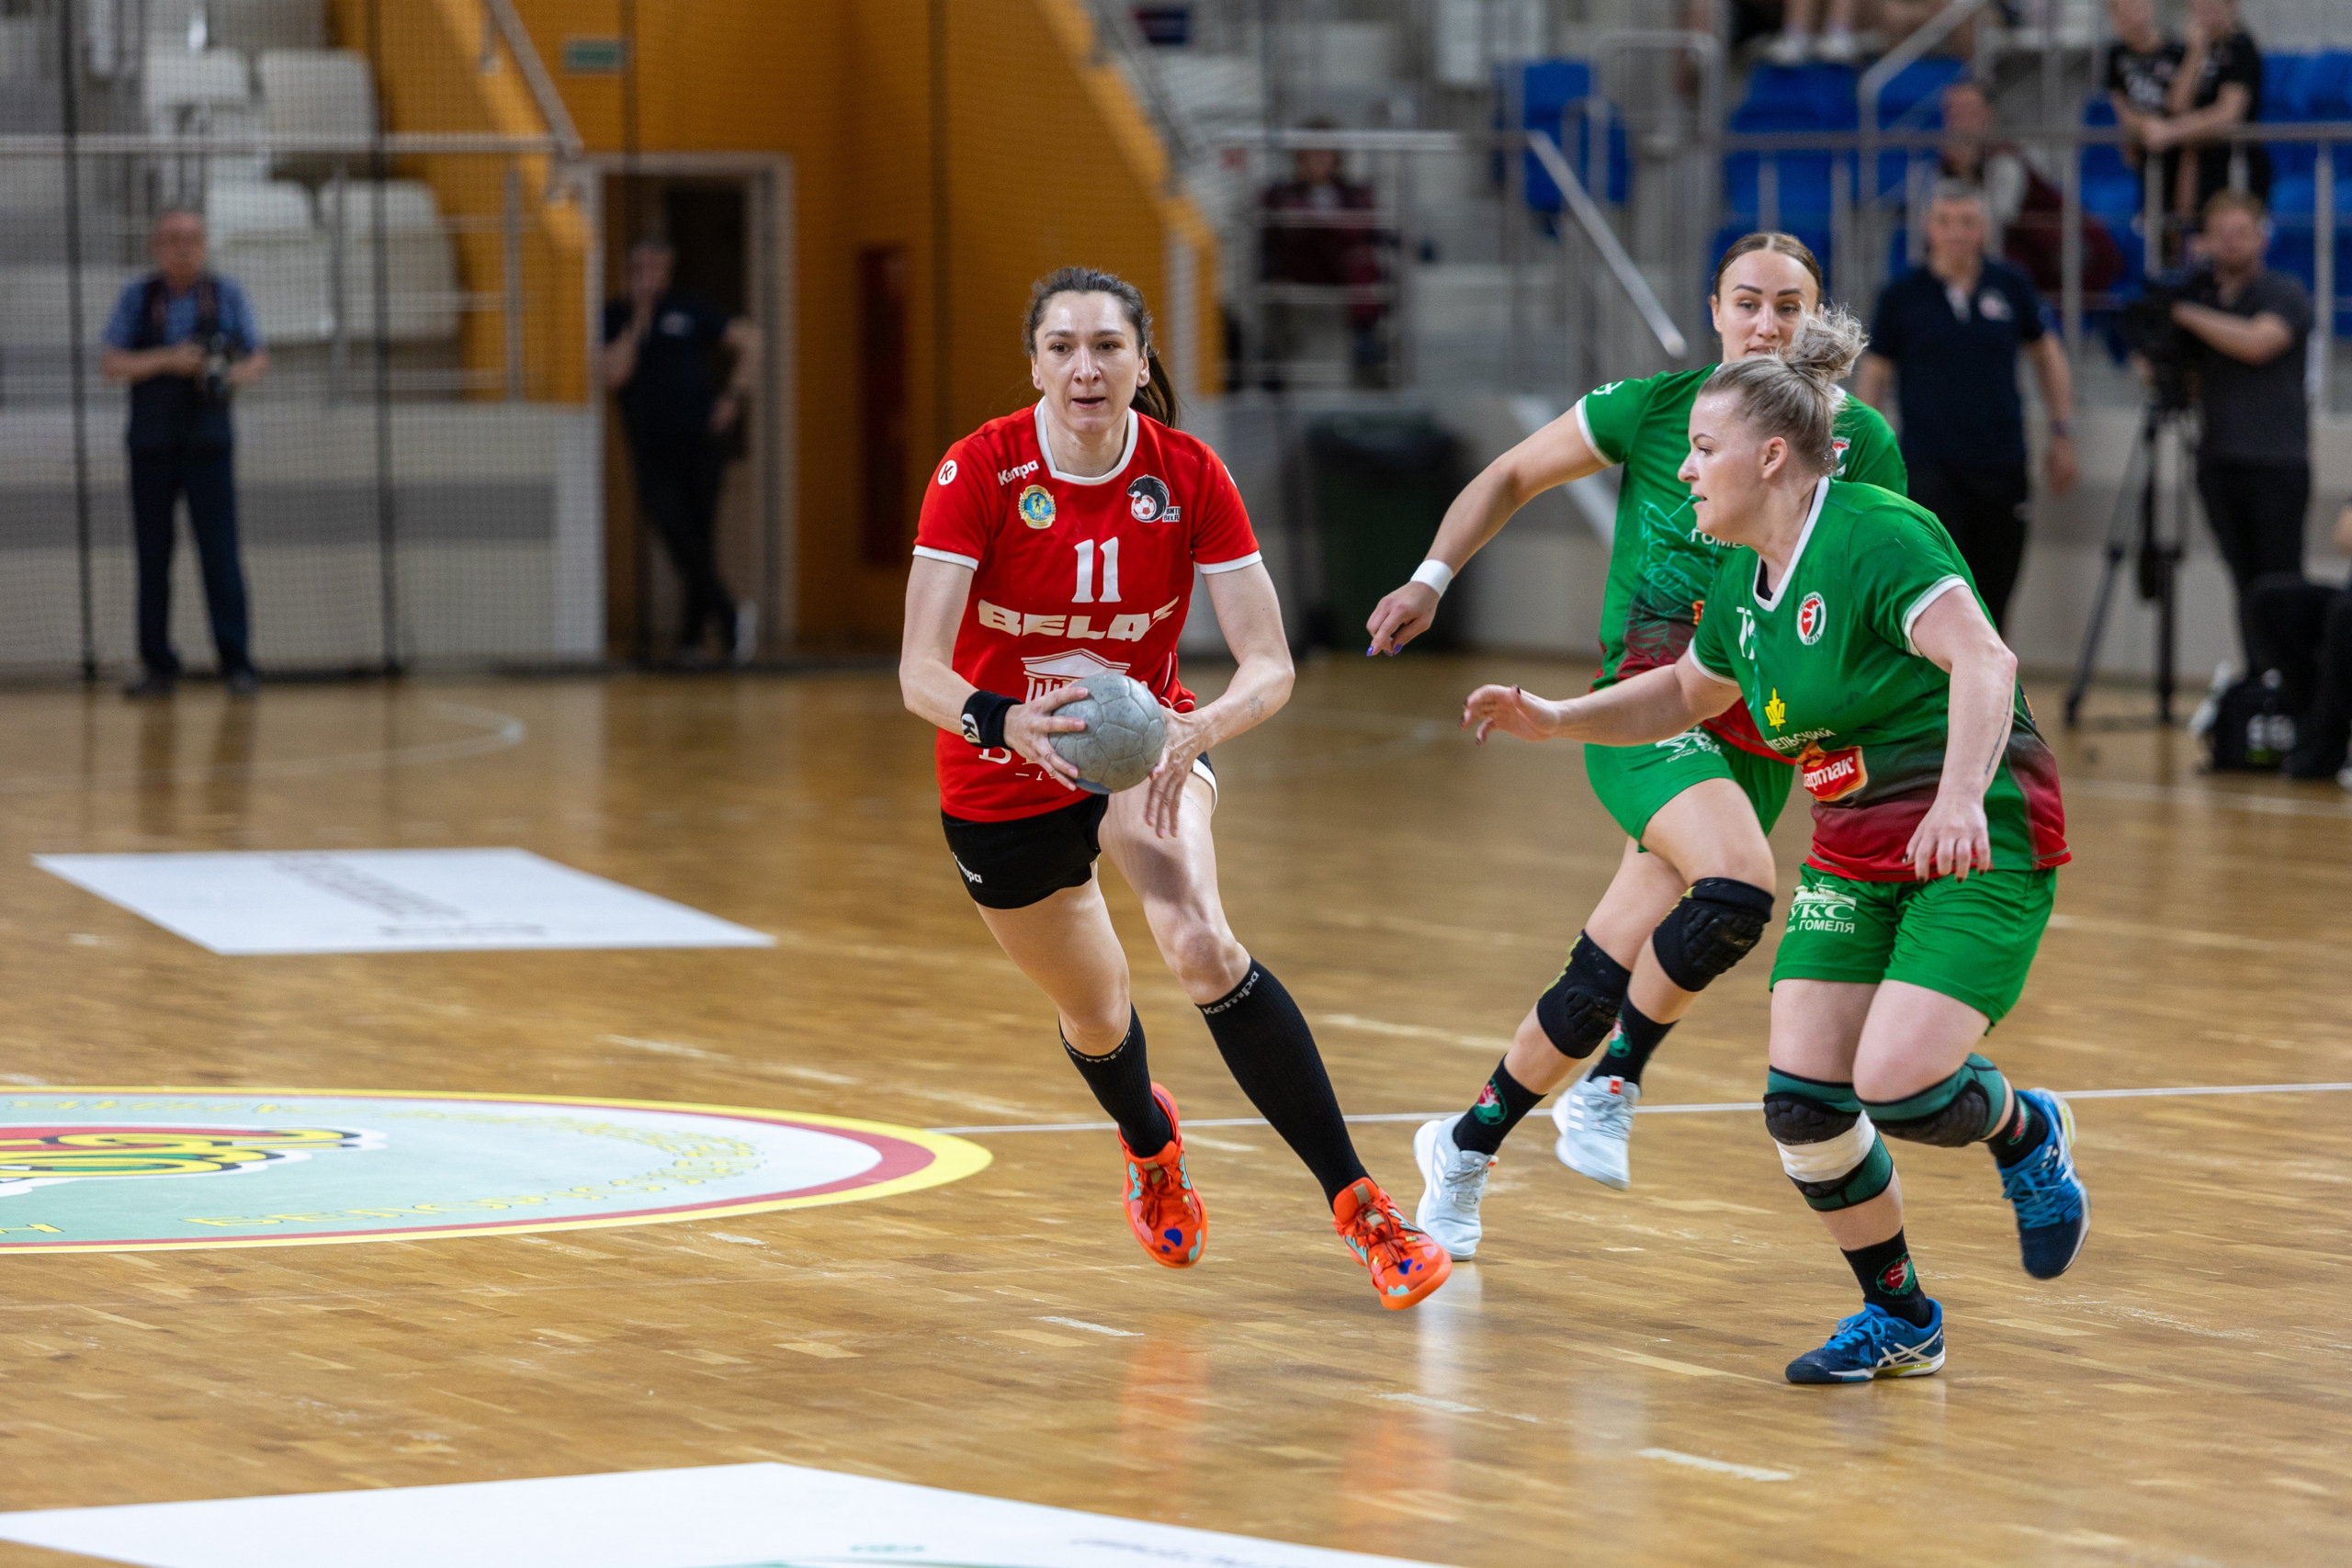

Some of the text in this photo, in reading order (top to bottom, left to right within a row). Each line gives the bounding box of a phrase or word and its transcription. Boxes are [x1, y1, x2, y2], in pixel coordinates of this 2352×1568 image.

[1071, 536, 1122, 603] 11
[1798, 919, 1856, 934] ГОМЕЛЯ
[1202, 970, 1260, 1015] Kempa
